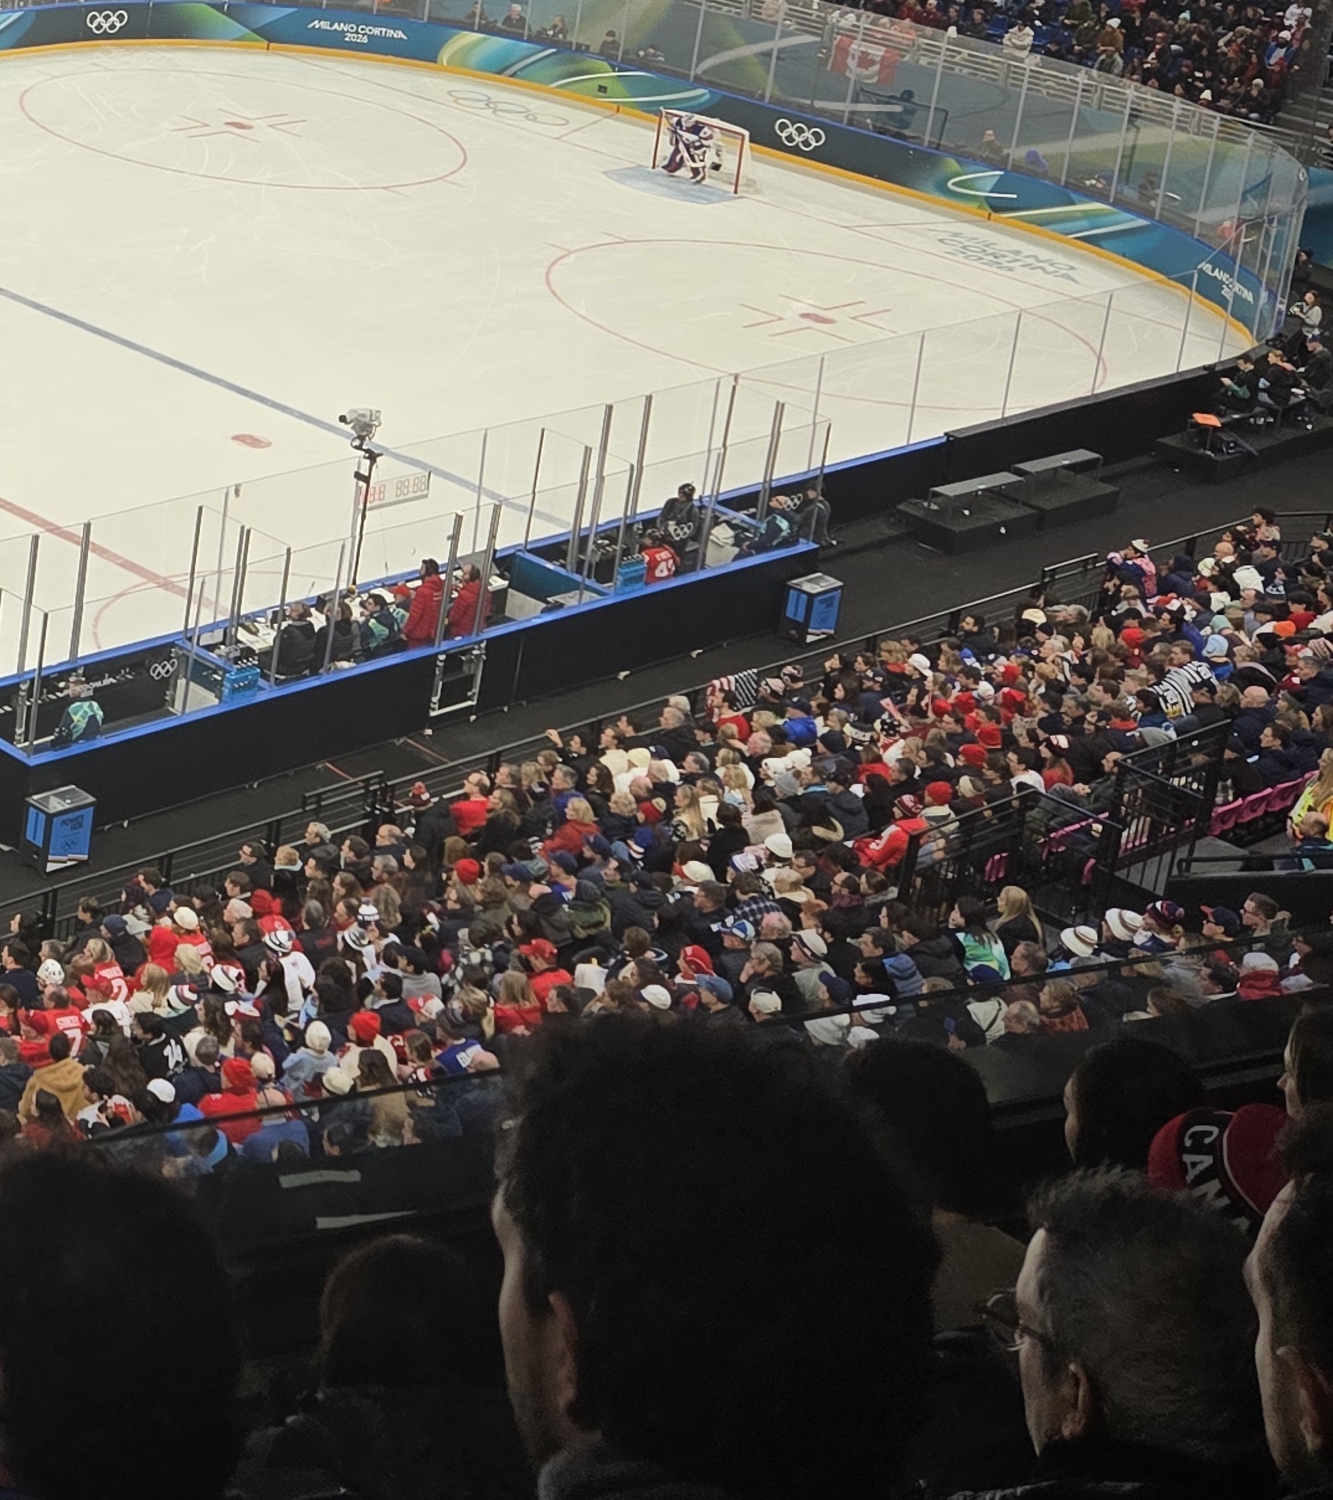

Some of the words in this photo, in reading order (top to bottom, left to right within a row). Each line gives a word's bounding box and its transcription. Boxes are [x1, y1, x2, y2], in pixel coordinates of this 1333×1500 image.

[307, 19, 356, 32] MILANO
[358, 24, 407, 40] CORTINA
[344, 32, 368, 43] 2026
[927, 228, 1077, 271] MILANO
[937, 238, 1080, 284] CORTINA
